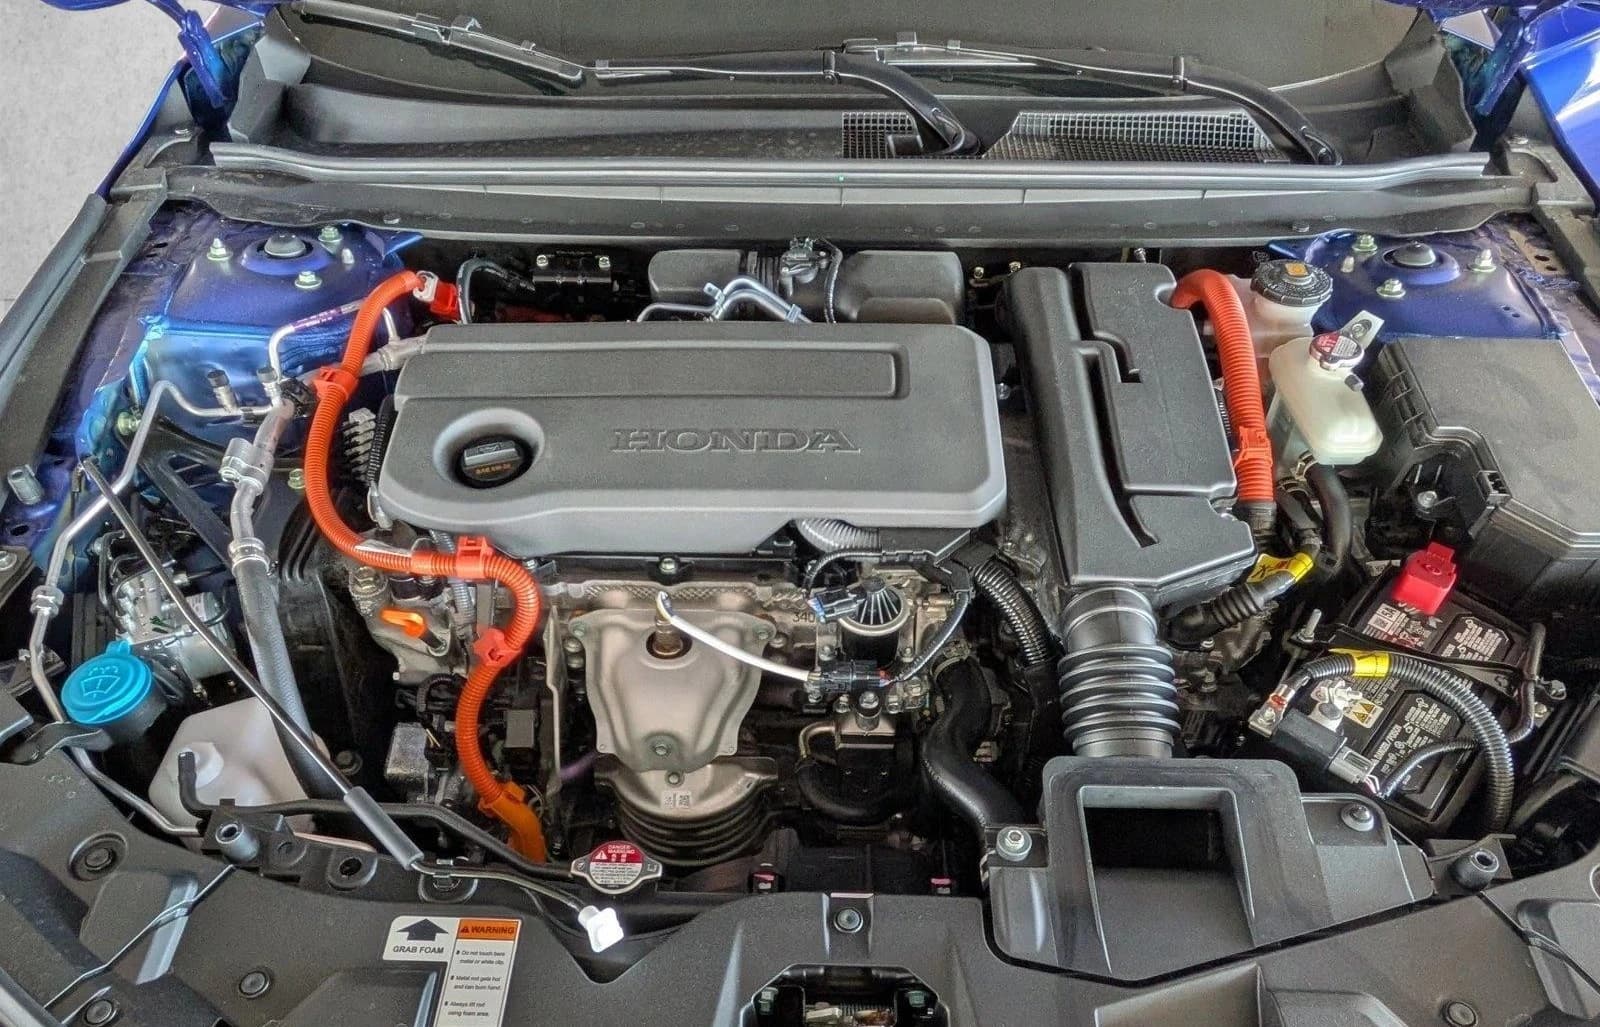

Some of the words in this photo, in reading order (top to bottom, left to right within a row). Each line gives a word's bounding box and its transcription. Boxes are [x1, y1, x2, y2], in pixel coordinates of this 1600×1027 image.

[611, 427, 862, 454] HONDA
[471, 925, 515, 934] WARNING
[392, 945, 417, 954] GRAB
[419, 945, 445, 955] FOAM
